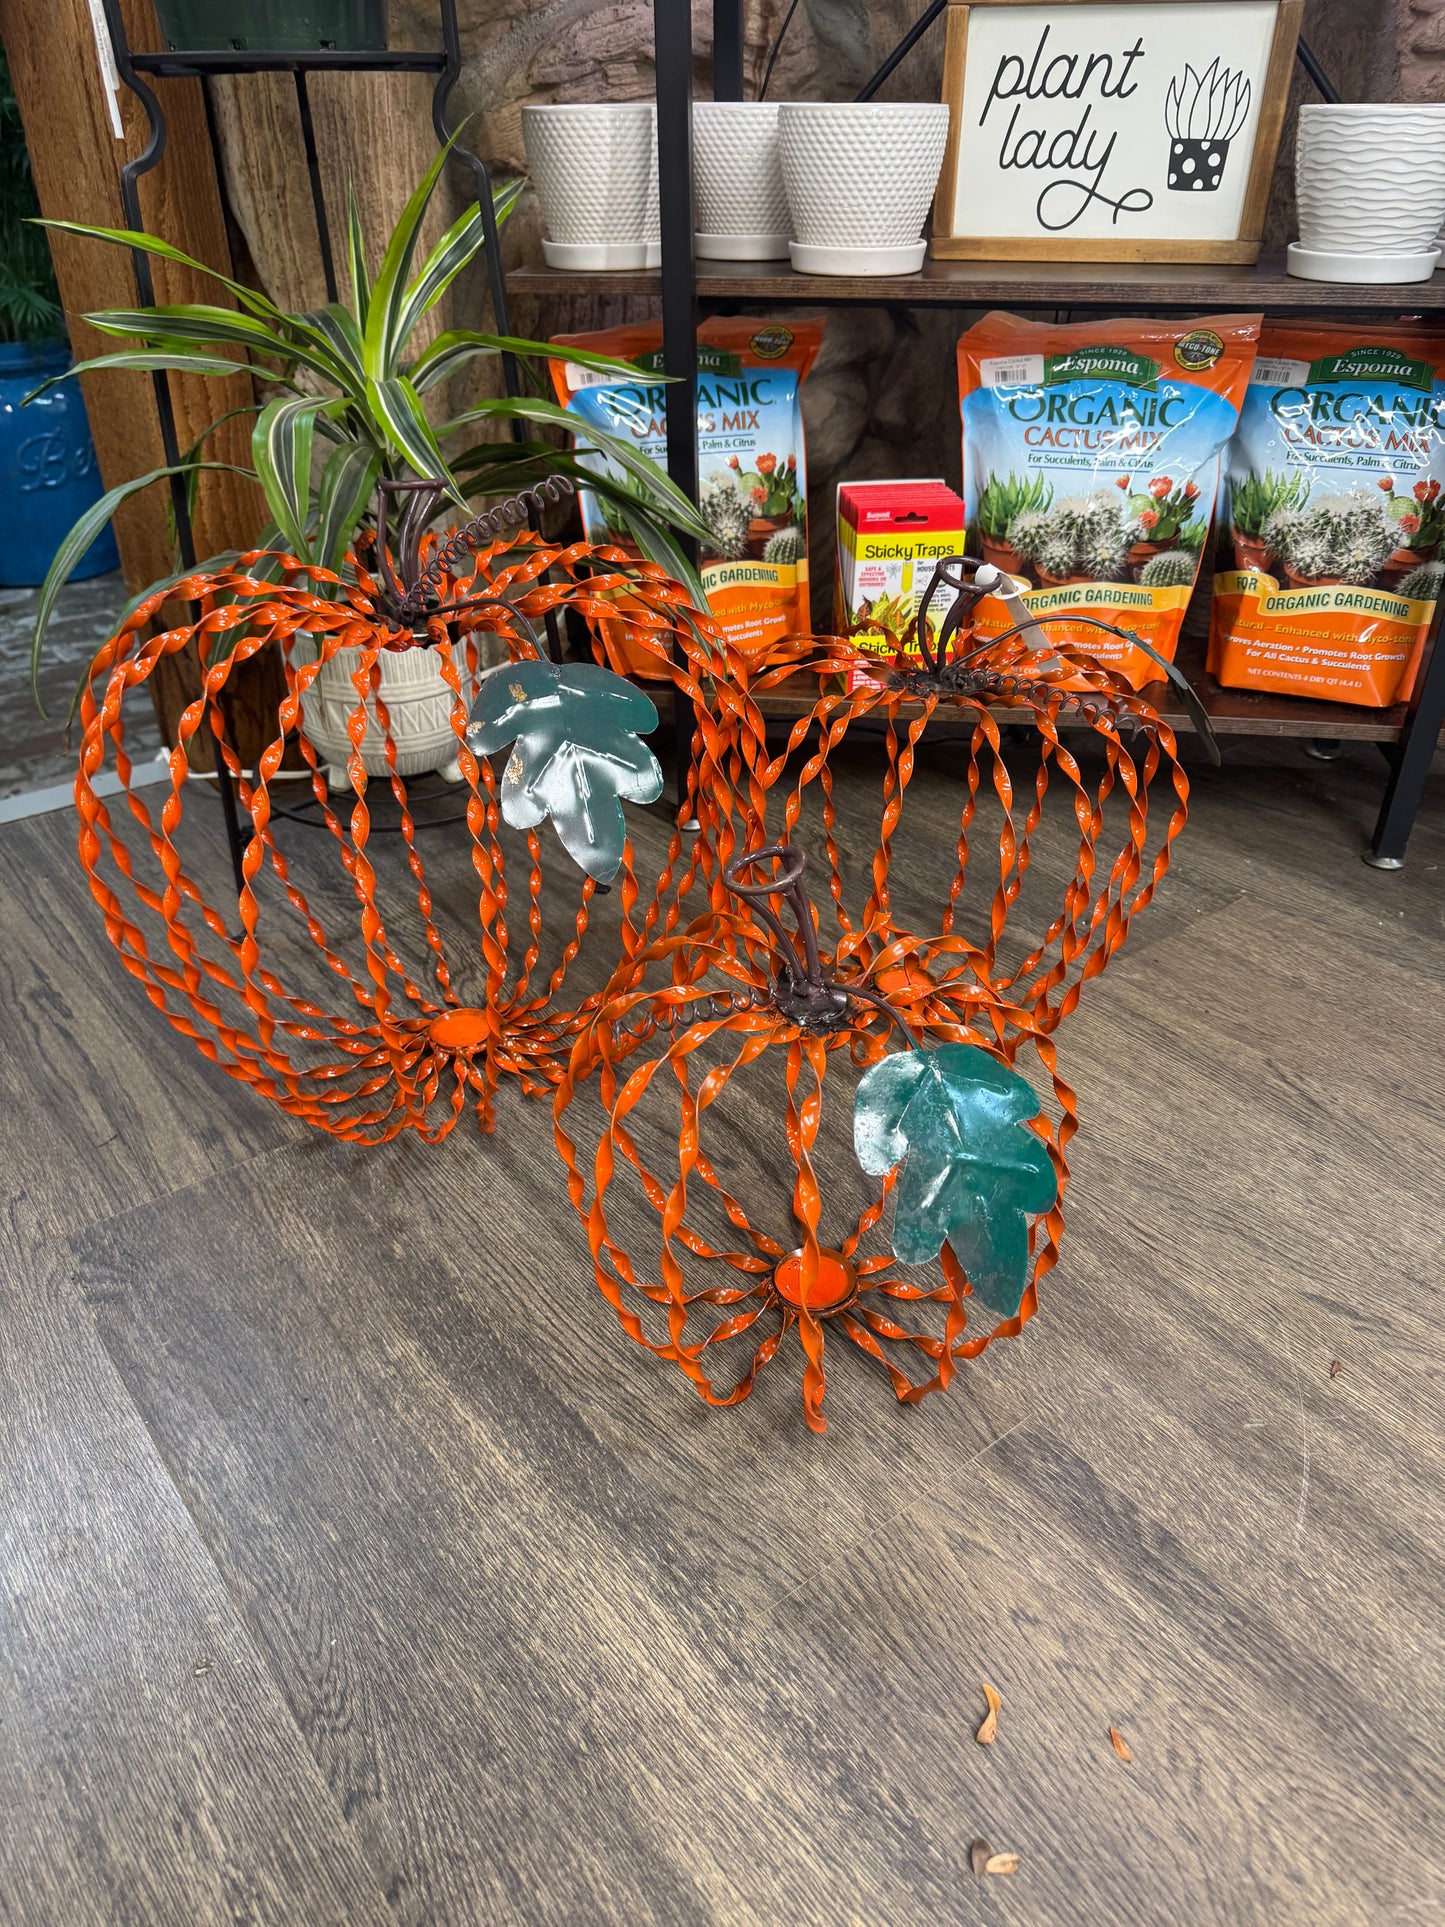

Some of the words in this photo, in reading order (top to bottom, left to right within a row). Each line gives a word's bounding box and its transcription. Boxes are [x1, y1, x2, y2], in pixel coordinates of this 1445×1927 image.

[978, 24, 1145, 127] plant
[999, 103, 1154, 231] lady
[1079, 348, 1106, 356] SINCE
[1350, 348, 1379, 358] SINCE
[1382, 349, 1402, 360] 1929
[1061, 356, 1139, 375] Espoma
[1331, 358, 1413, 377] Espoma
[1008, 391, 1185, 427] ORGANIC
[722, 410, 760, 432] MIX
[703, 440, 722, 450] Palm
[724, 439, 731, 448] &
[733, 438, 756, 448] Citrus
[1024, 426, 1114, 449] CACTUS
[1119, 430, 1164, 451] MIX
[1385, 430, 1430, 453] MIX
[1028, 453, 1042, 464] For
[1044, 454, 1092, 468] Succulents,
[1119, 458, 1127, 467] &
[1356, 456, 1381, 467] Palm
[1392, 459, 1421, 471] Citrus
[865, 543, 913, 561] Sticky
[915, 543, 954, 559] Traps
[720, 567, 778, 582] GARDENING
[1236, 576, 1258, 591] FOR
[1085, 589, 1153, 605] GARDENING
[1266, 592, 1330, 610] ORGANIC
[1334, 592, 1409, 617] GARDENING
[981, 618, 1017, 629] Natura
[1275, 623, 1329, 639] Enhanced
[1333, 631, 1358, 643] with
[1252, 639, 1293, 652] Aeration
[1302, 645, 1347, 658] Promotes
[1350, 651, 1372, 660] Root
[1245, 648, 1262, 657] For
[1263, 651, 1277, 660] All
[1278, 653, 1309, 664] Cactus
[1311, 657, 1319, 665] &
[1321, 658, 1371, 671] Succulents
[1246, 667, 1261, 675] NET
[1262, 668, 1302, 680] CONTENTS
